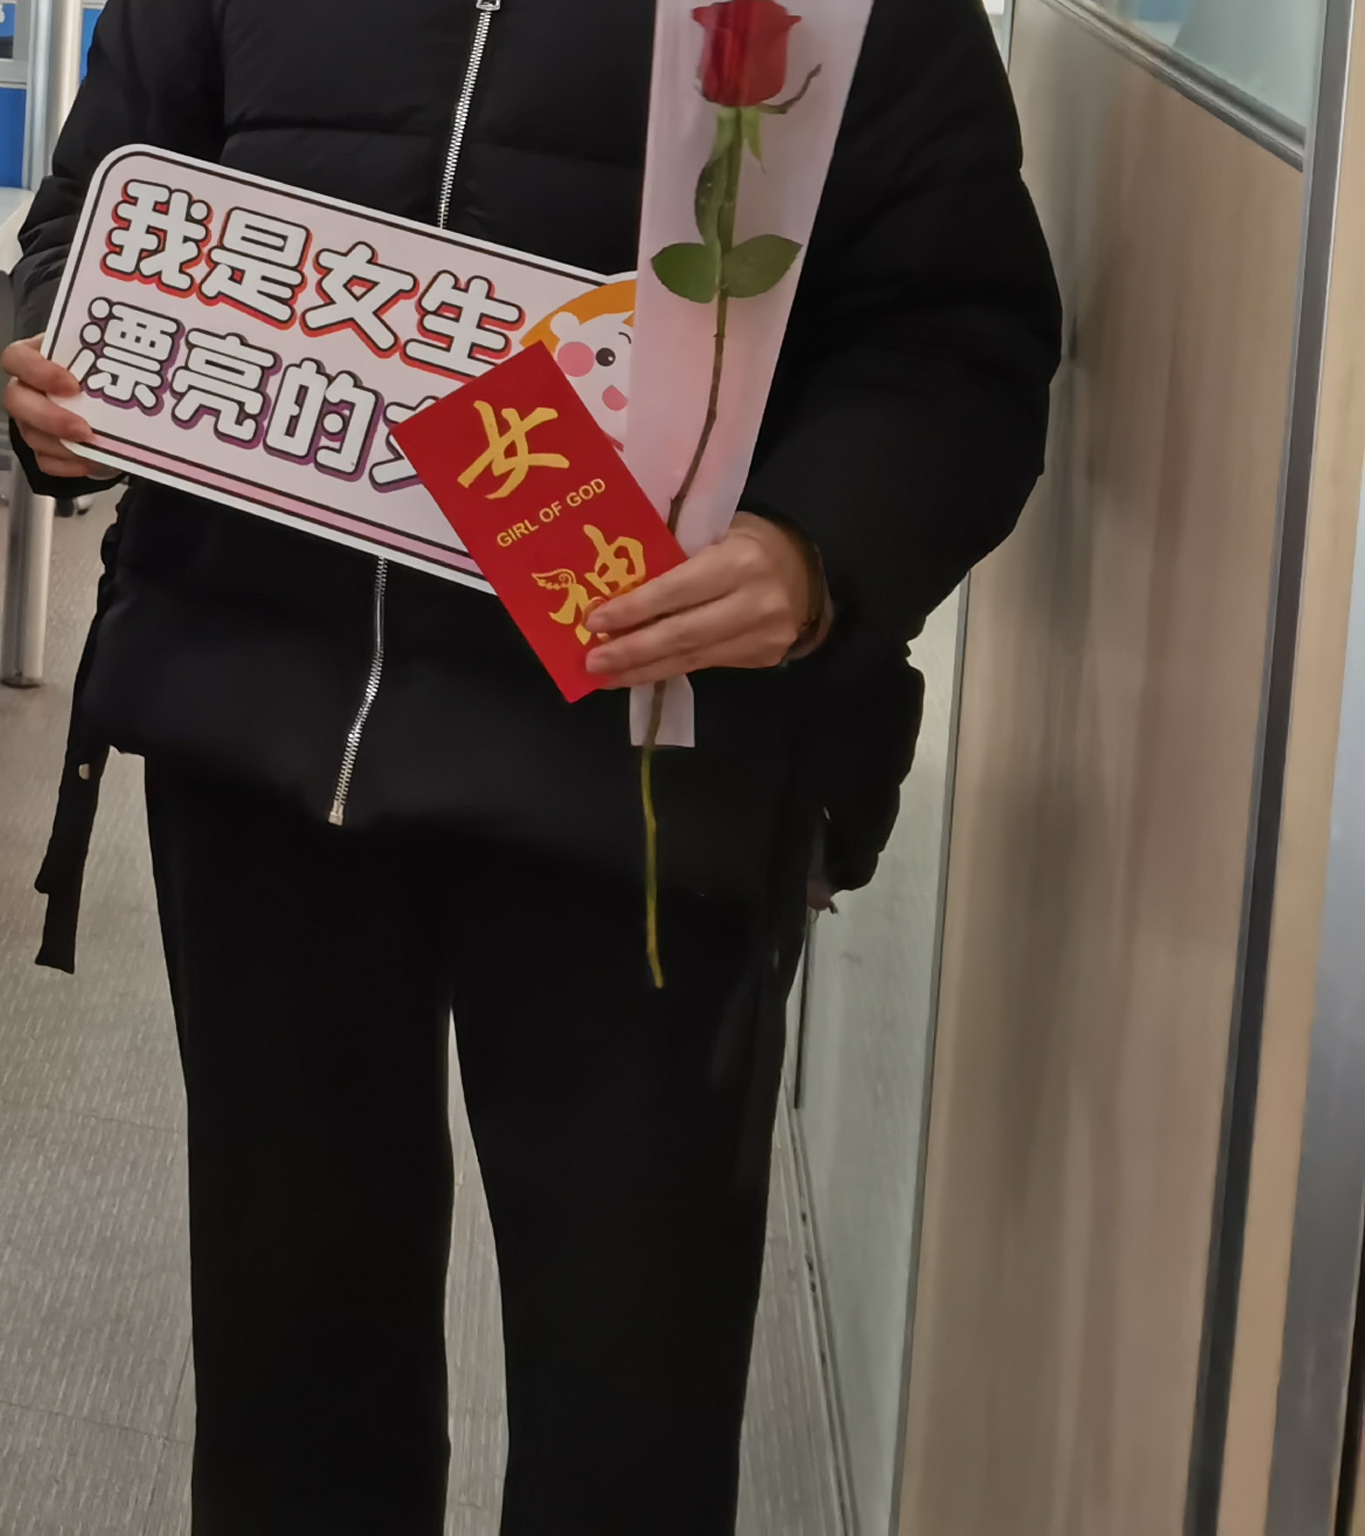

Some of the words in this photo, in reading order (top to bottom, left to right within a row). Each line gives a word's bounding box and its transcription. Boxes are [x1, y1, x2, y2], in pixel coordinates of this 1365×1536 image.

[100, 178, 527, 385] 我是女生
[457, 399, 572, 501] 女
[496, 518, 540, 548] GIRL
[538, 500, 563, 524] OF
[566, 477, 607, 508] GOD
